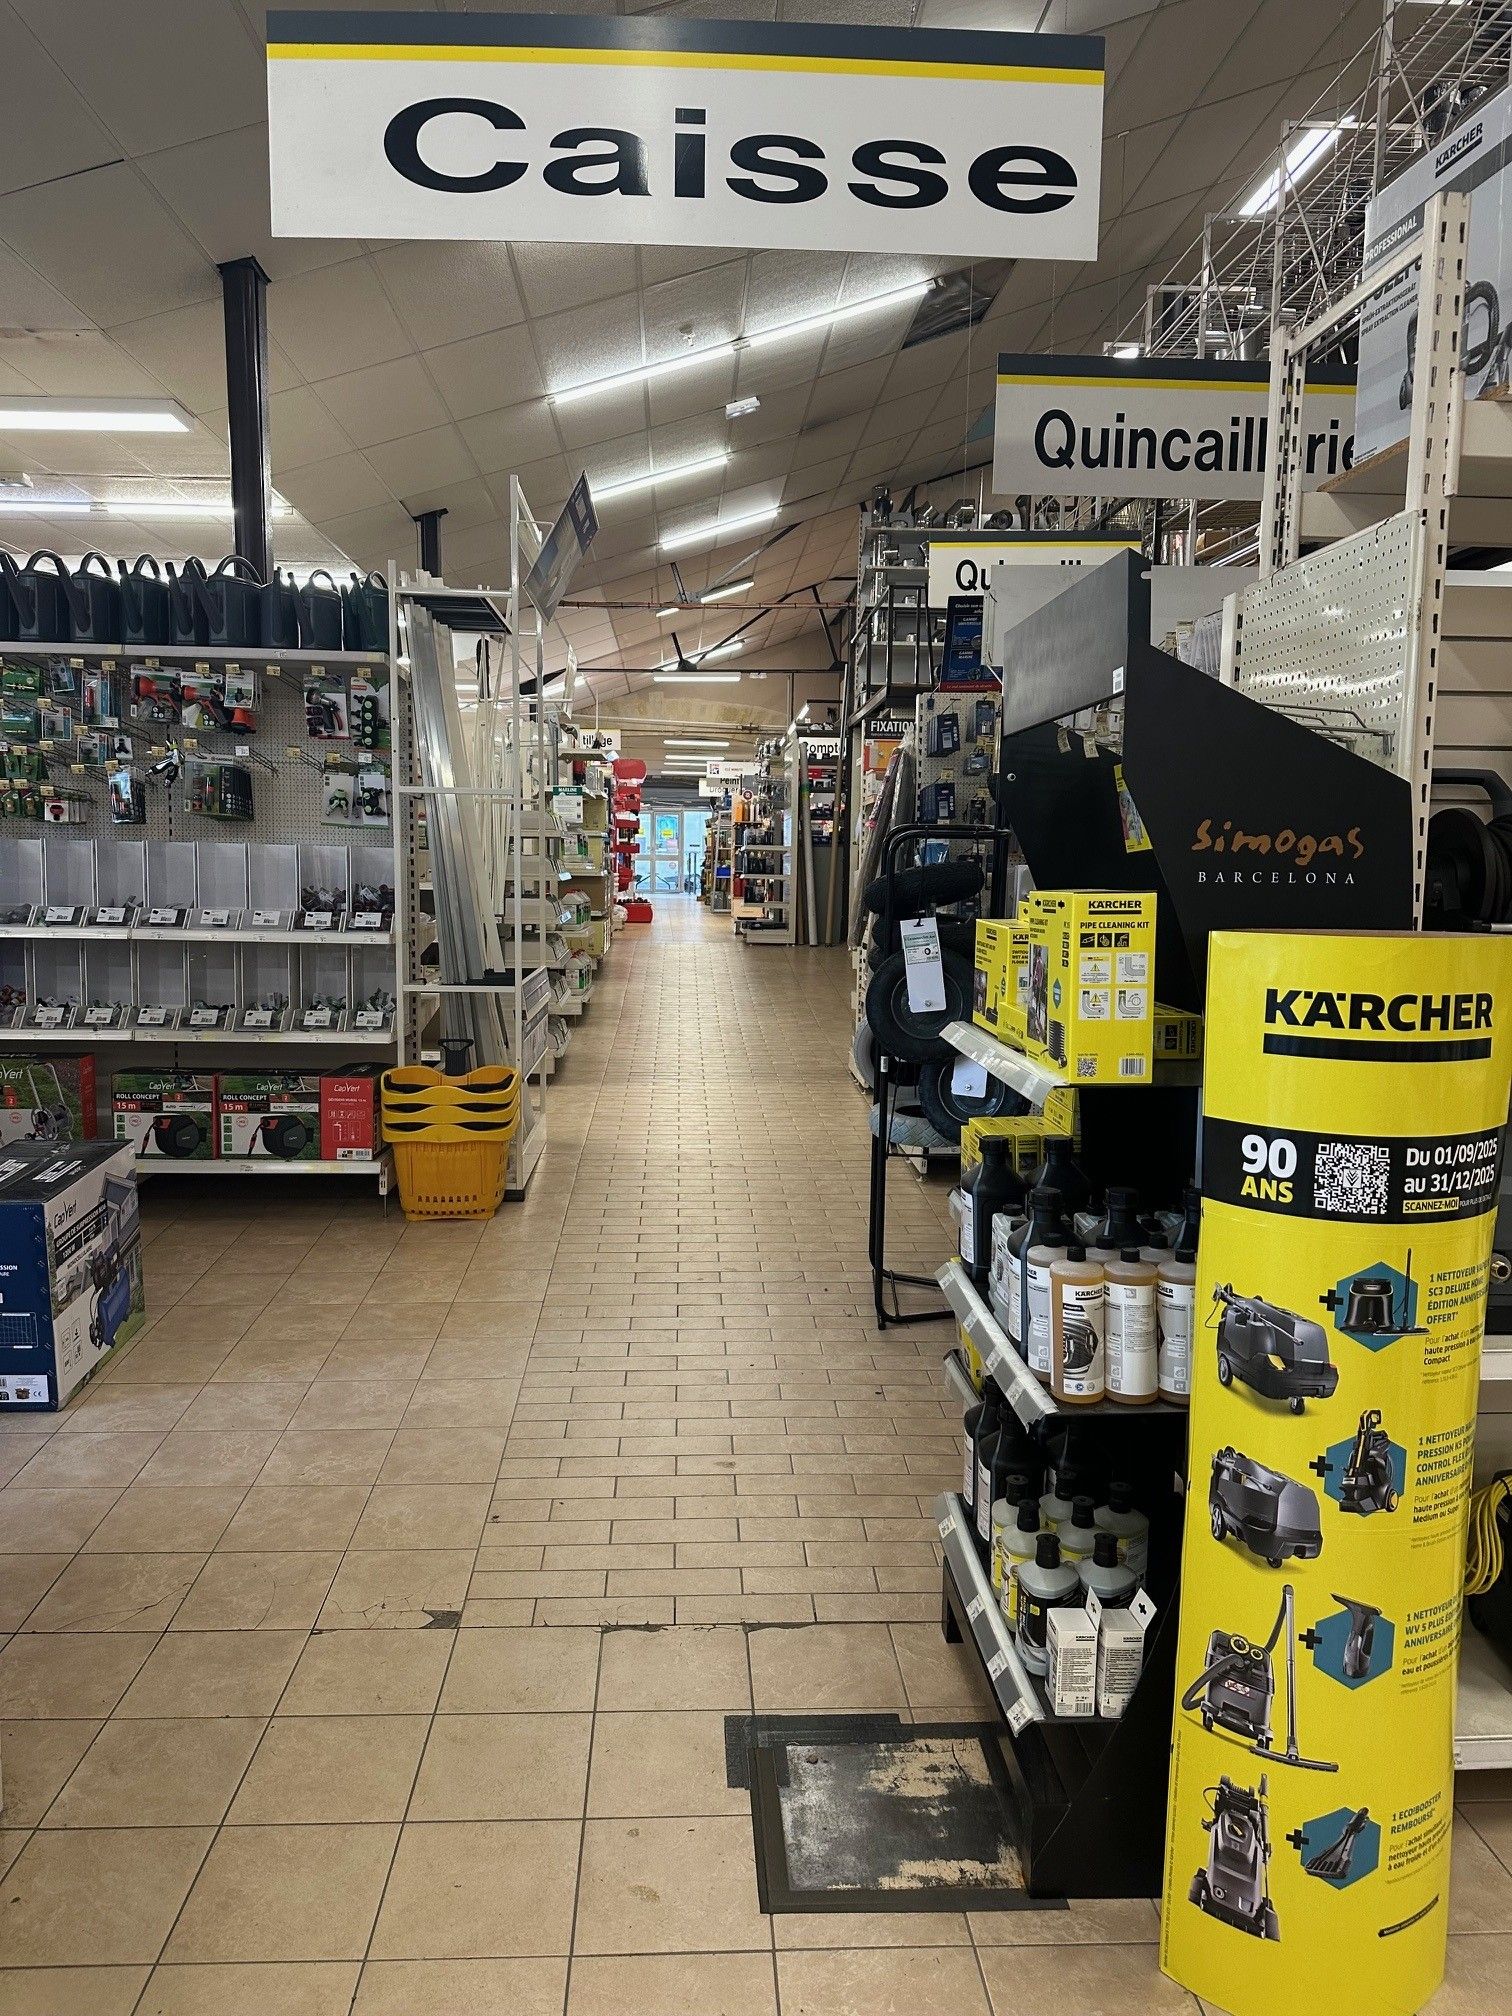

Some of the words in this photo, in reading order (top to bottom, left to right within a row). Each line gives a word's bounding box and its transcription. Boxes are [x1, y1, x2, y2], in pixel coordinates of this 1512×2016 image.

[383, 96, 1079, 215] Caisse
[1364, 215, 1418, 263] PROFESSIONAL
[1035, 408, 1355, 475] Quincaillri
[1190, 818, 1365, 866] Simogas
[1198, 871, 1355, 884] BARCELONA
[1080, 921, 1097, 929] PIPE
[1098, 921, 1135, 929] CLEANING
[1137, 921, 1150, 929] KIT
[1263, 988, 1494, 1032] KÄRCHER
[149, 1079, 175, 1091] CapVert
[256, 1080, 282, 1091] CapVert
[117, 1102, 126, 1110] 15
[223, 1103, 234, 1111] 15
[1241, 1134, 1298, 1179] 90
[1406, 1147, 1431, 1167] Du
[1434, 1137, 1498, 1167] 01/09/2025
[1404, 1177, 1427, 1194] au
[1430, 1163, 1495, 1194] 31/12/2025
[1240, 1175, 1294, 1204] ANS
[1404, 1198, 1458, 1212] SCANNEZ-MOI
[1429, 1273, 1434, 1283] 1
[1436, 1266, 1476, 1283] NETTOYEUR
[1428, 1286, 1443, 1297] SC3
[1445, 1280, 1470, 1295] DELUXE
[1427, 1298, 1459, 1311] ÉDITION
[1424, 1346, 1443, 1356] haute
[1444, 1339, 1466, 1353] pression
[1425, 1335, 1440, 1345] Pour
[1423, 1354, 1451, 1366] Compact
[1418, 1436, 1424, 1446] 1
[1425, 1426, 1465, 1445] NETTOYEUR
[1417, 1445, 1454, 1460] PRESSION
[1416, 1458, 1451, 1473] CONTROL
[1413, 1504, 1432, 1513] haute
[1433, 1497, 1455, 1511] pression
[1412, 1512, 1438, 1524] Medium
[1439, 1510, 1446, 1519] ou
[1406, 1613, 1411, 1622] 1
[1413, 1599, 1453, 1621] NETTOYEUR
[1405, 1624, 1420, 1636] WV
[1421, 1623, 1427, 1632] 5
[1428, 1616, 1444, 1630] PLUS
[1402, 1667, 1415, 1676] eau
[1392, 1812, 1397, 1822] 1
[1388, 1846, 1418, 1862] nettoyeur
